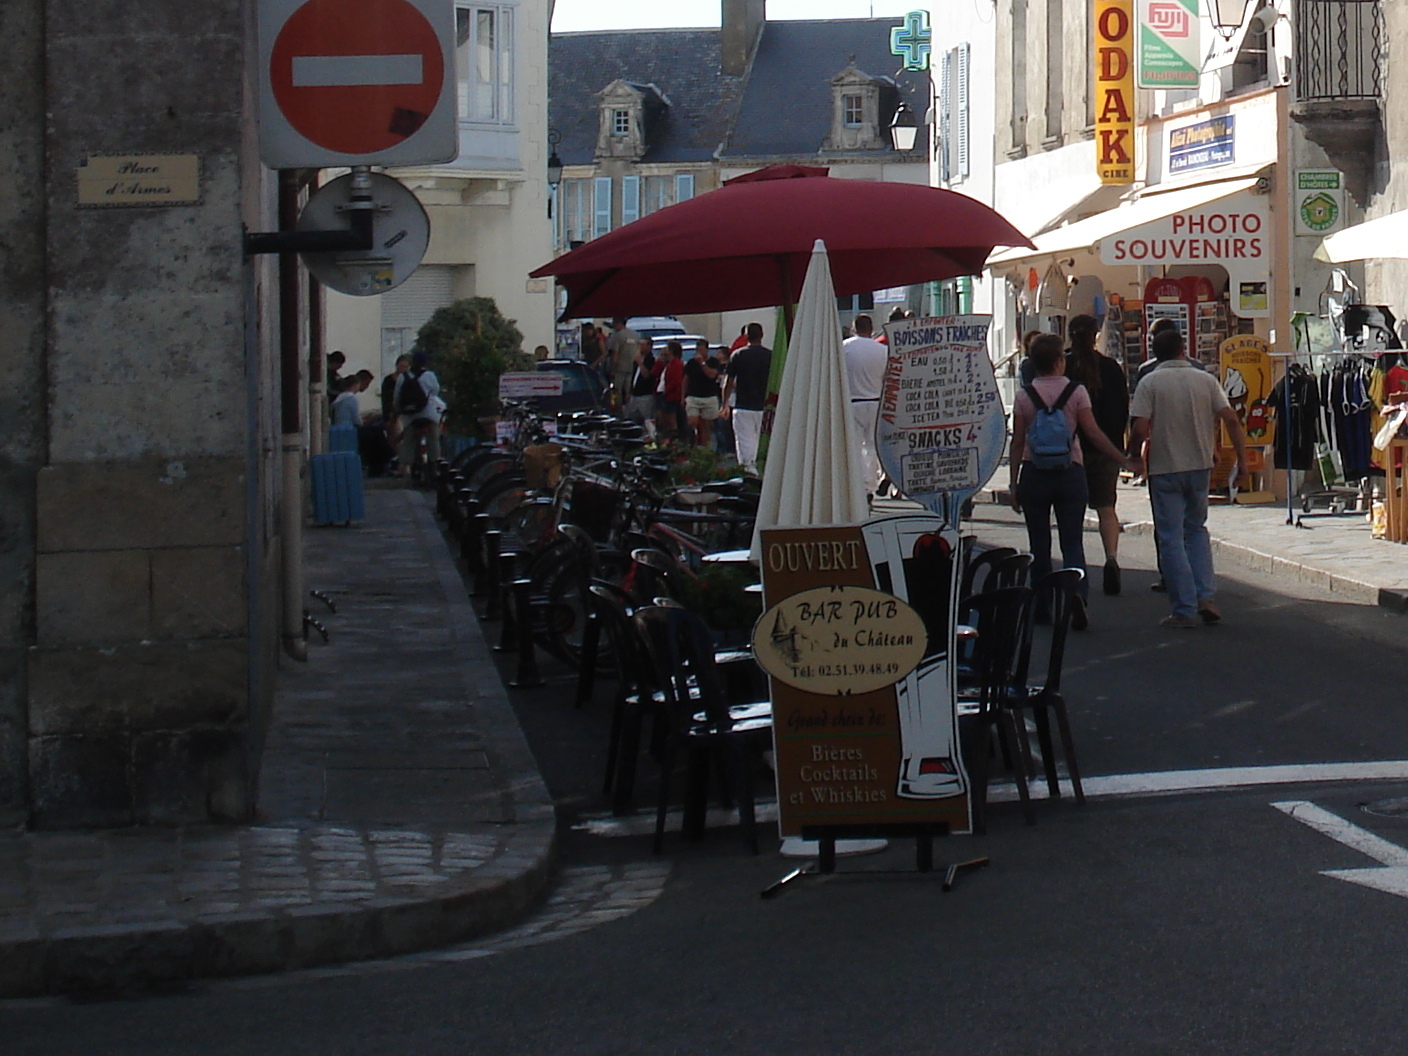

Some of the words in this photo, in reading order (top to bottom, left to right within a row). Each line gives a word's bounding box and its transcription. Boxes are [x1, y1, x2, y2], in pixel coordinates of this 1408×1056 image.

[1149, 3, 1188, 37] FUJI
[1144, 71, 1197, 81] FUJIFILM
[118, 162, 159, 174] Place
[1103, 169, 1129, 179] CINE
[106, 182, 171, 195] d'Armes
[1172, 214, 1262, 235] PHOTO
[1115, 237, 1262, 260] SOUVENIRS
[893, 326, 943, 346] BOISSONS
[911, 357, 928, 367] EAU
[906, 390, 921, 401] COCA
[924, 388, 939, 400] COLA
[908, 428, 962, 448] SNACKS
[769, 540, 860, 572] OUVERT
[797, 601, 842, 625] BAR
[850, 600, 898, 625] PUB
[833, 632, 849, 648] du
[854, 629, 914, 647] Château
[818, 663, 899, 677] 02.51.39.48.49
[812, 744, 863, 762] Bières
[801, 764, 878, 782] Cocktails
[790, 791, 805, 804] et
[810, 784, 887, 803] Whiskies
